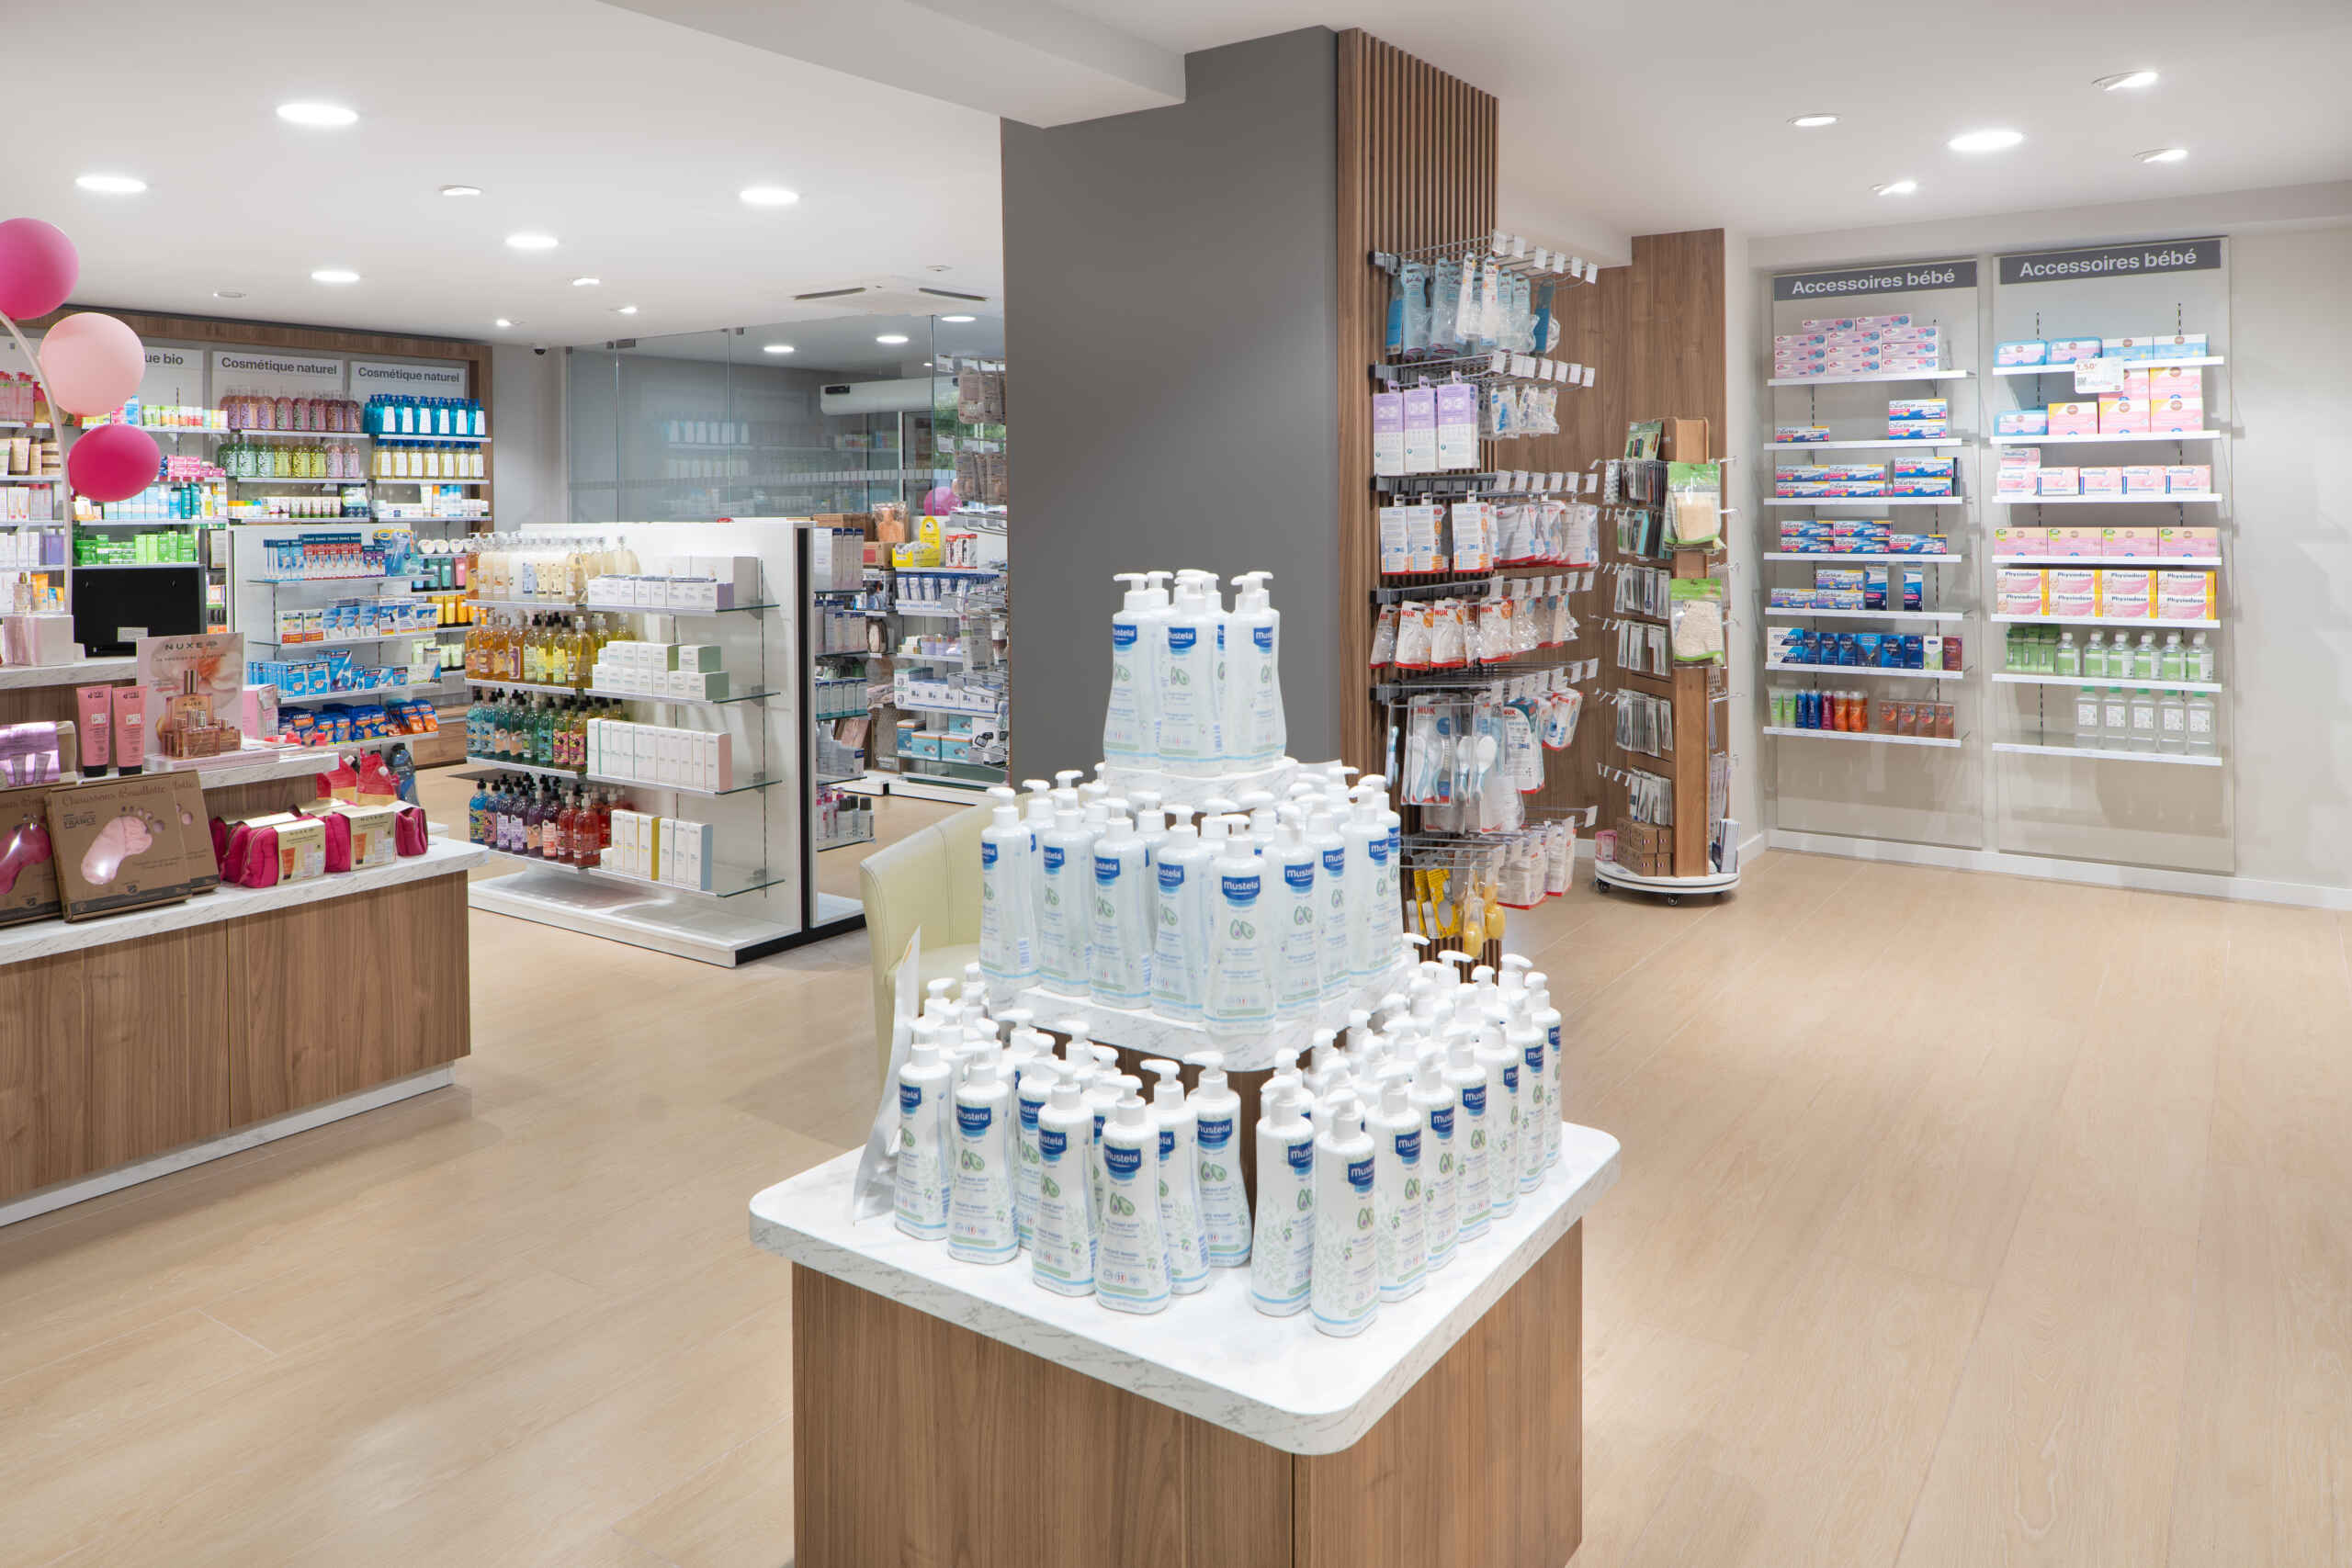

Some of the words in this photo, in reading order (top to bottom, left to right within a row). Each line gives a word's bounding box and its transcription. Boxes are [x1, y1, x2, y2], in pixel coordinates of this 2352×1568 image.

[2019, 254, 2140, 277] Accessoires
[2144, 248, 2198, 268] bébé
[1792, 275, 1903, 295] Accessoires
[1906, 267, 1956, 287] bébé
[164, 354, 184, 366] bio
[221, 357, 294, 373] Cosmétique
[297, 364, 337, 375] naturel
[358, 367, 423, 381] Cosmétique
[424, 372, 459, 382] naturel
[1435, 609, 1448, 617] NUK
[1113, 628, 1135, 637] ustela
[165, 641, 203, 650] NUXE
[1418, 705, 1436, 715] NUK
[1224, 880, 1259, 889] Mustela
[1039, 1135, 1065, 1146] ustela
